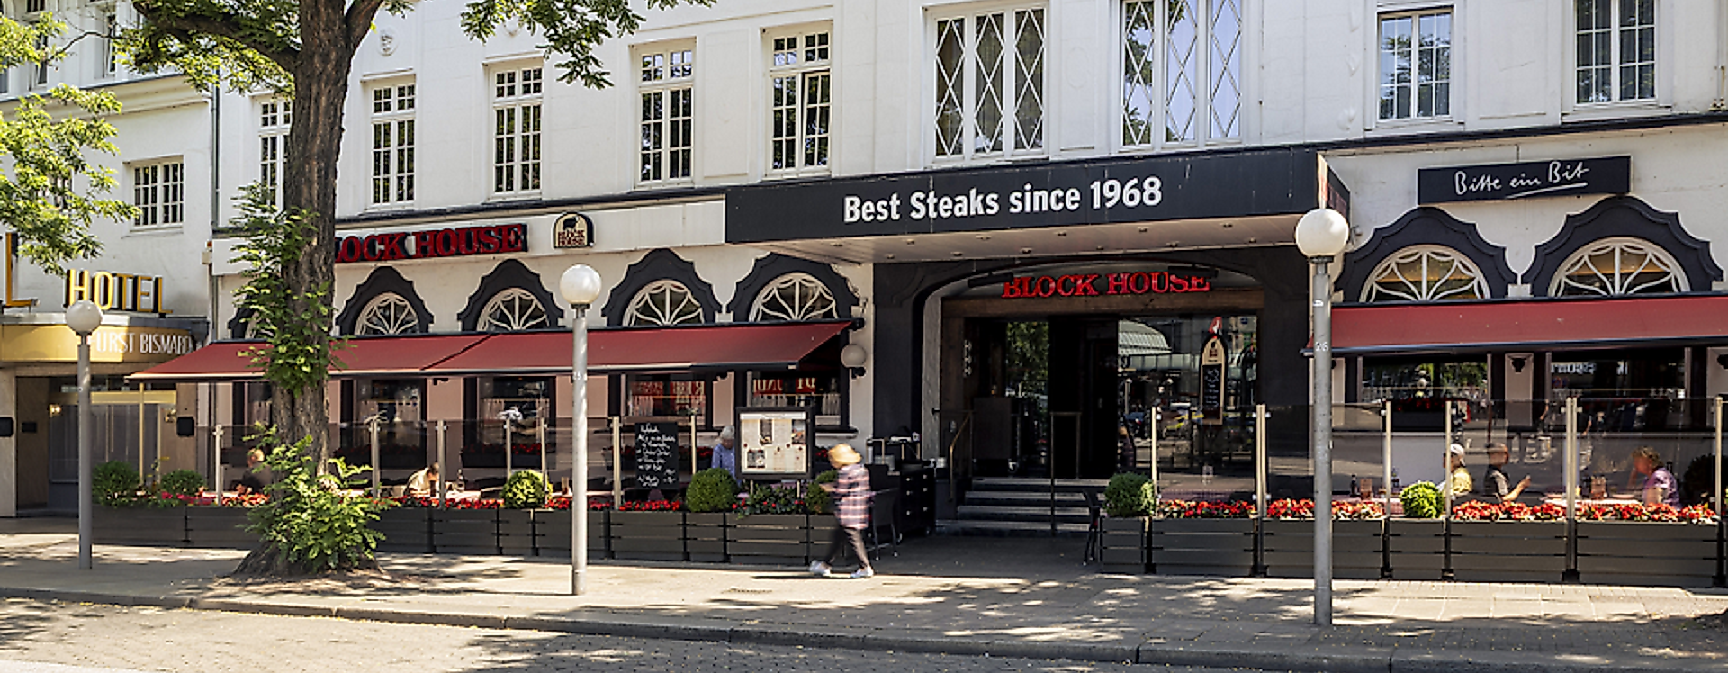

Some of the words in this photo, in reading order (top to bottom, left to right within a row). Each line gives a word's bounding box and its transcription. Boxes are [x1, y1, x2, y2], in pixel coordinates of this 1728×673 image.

[1454, 171, 1502, 195] Bitte
[1509, 173, 1541, 188] ein
[1548, 161, 1590, 183] Bit
[843, 192, 901, 223] Best
[910, 187, 1000, 220] Steaks
[1009, 182, 1081, 213] since
[1090, 176, 1162, 210] 1968
[411, 223, 522, 258] HOUSE
[66, 268, 173, 314] HOTEL
[1001, 274, 1099, 298] BLOCK
[1105, 271, 1210, 294] HOUSE
